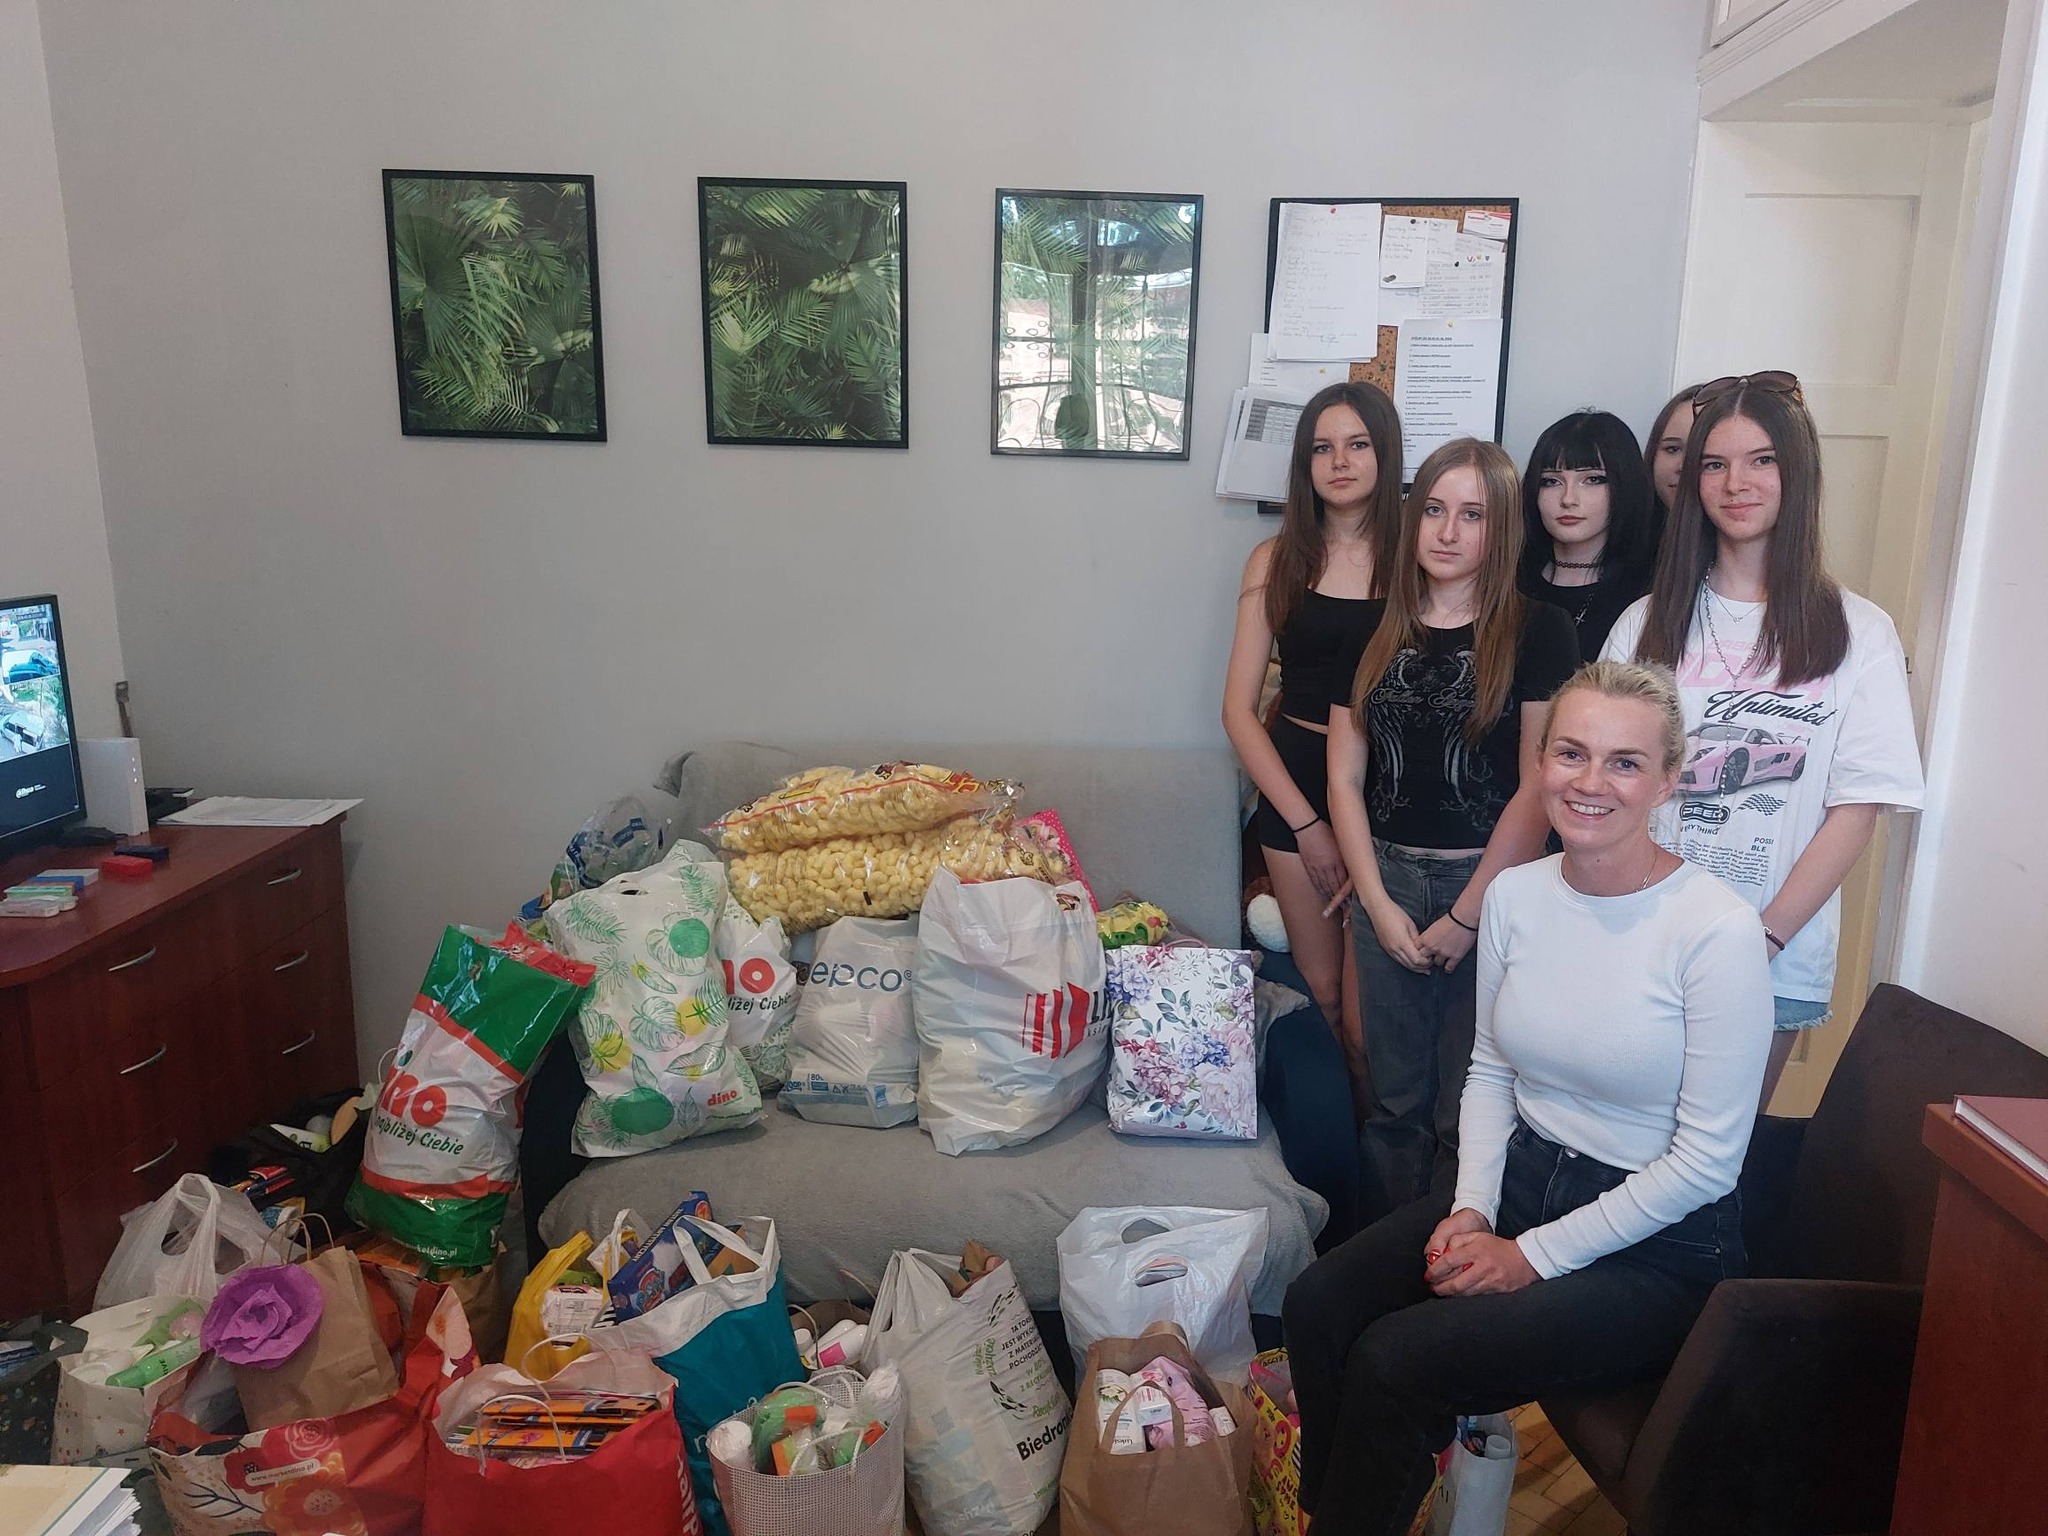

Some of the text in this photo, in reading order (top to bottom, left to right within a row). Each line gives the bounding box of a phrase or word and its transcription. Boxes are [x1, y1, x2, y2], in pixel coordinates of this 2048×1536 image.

[1704, 688, 1837, 726] Unlimited
[708, 1090, 737, 1106] dino
[420, 1133, 464, 1155] Ciebie
[1001, 1339, 1017, 1351] JEST
